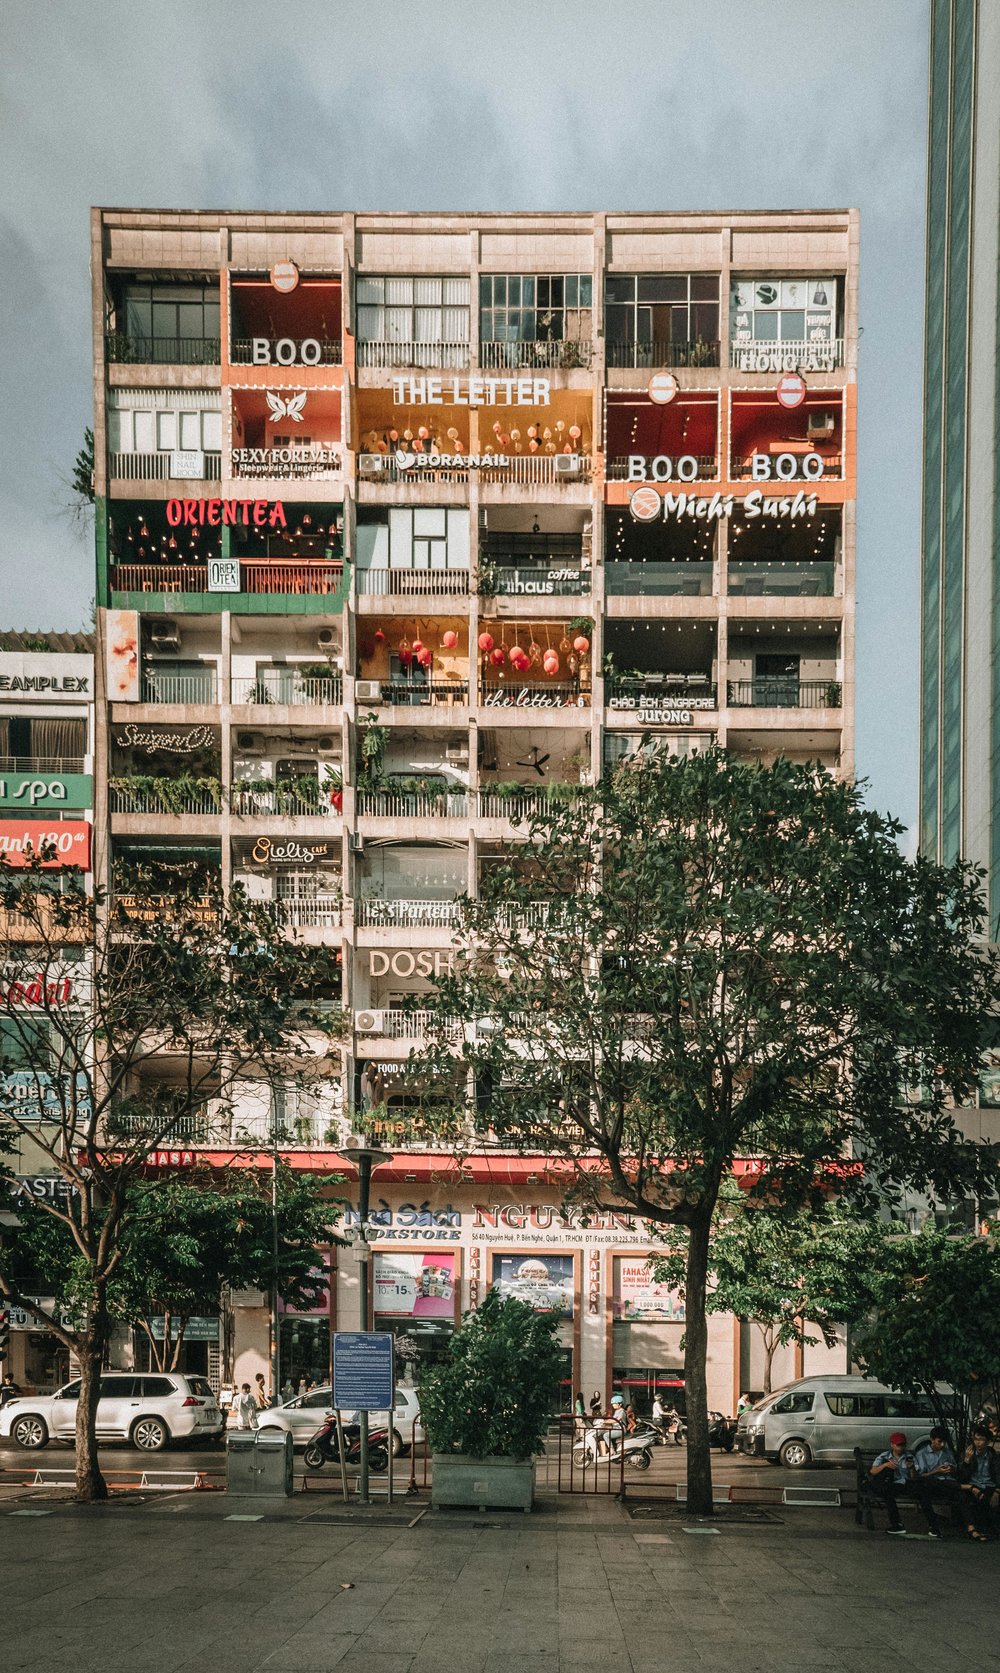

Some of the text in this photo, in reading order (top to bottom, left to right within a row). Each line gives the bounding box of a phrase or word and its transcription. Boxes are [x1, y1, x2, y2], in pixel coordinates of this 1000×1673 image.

[252, 338, 322, 366] BOO
[392, 377, 550, 406] THE LETTER
[176, 453, 197, 461] SHIN
[232, 448, 339, 464] SEXY FOREVER
[417, 453, 509, 467] BORA NAIL
[627, 454, 699, 483] BOO
[752, 452, 825, 481] BOO
[166, 498, 287, 527] ORIENTEA
[664, 489, 818, 521] Michi Sushi
[547, 569, 579, 580] coffee
[484, 690, 513, 707] the
[516, 688, 566, 708] letter
[667, 698, 719, 709] SINGAPORE
[13, 781, 66, 805] spa
[377, 1064, 399, 1073] FOOD
[622, 1268, 650, 1276] FAHASA
